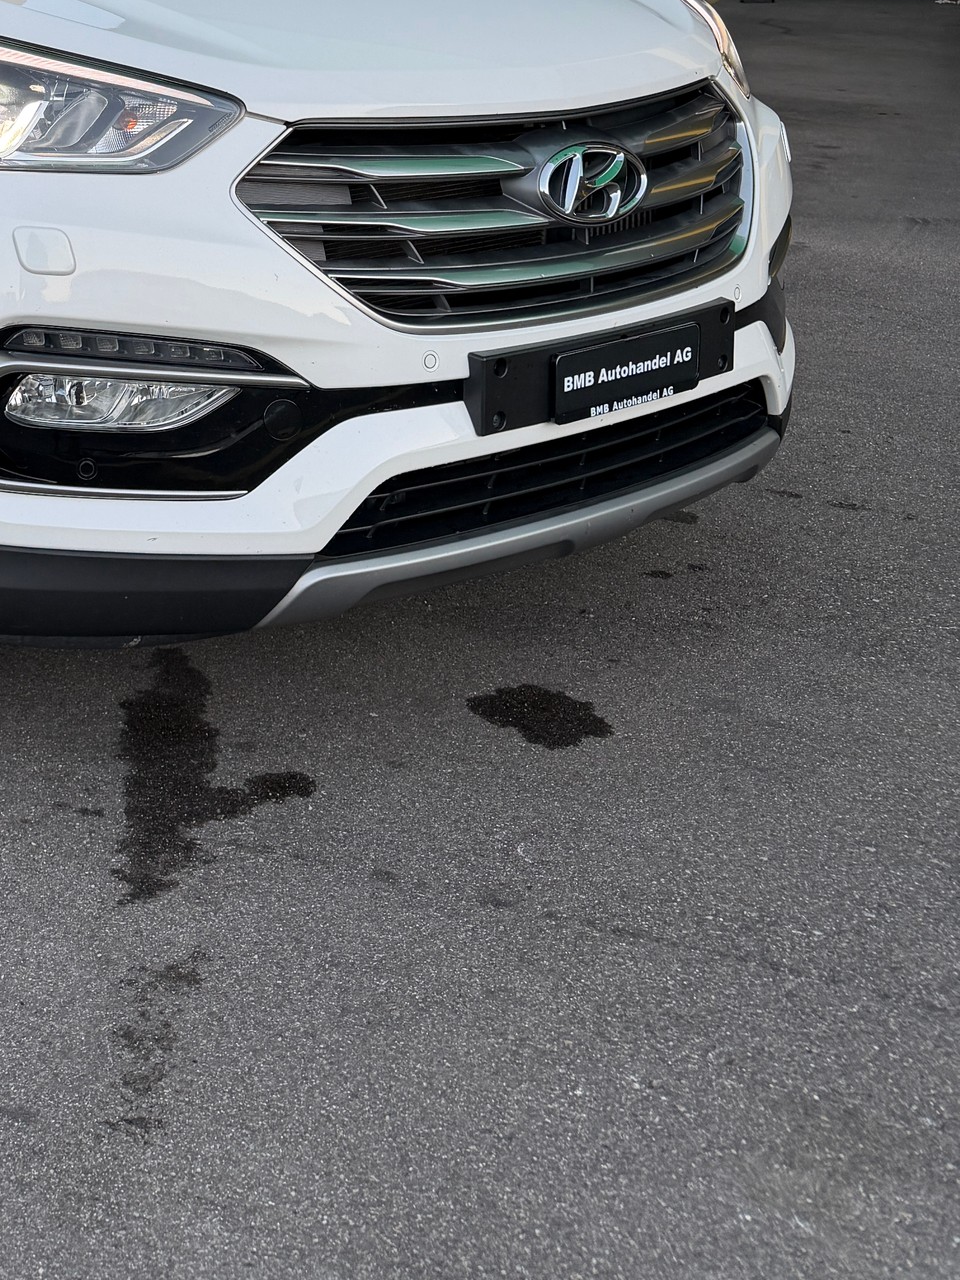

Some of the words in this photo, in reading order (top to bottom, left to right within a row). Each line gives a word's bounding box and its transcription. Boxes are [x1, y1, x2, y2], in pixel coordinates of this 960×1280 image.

[564, 371, 594, 392] BMB
[598, 352, 671, 384] Autohandel
[673, 347, 692, 365] AG
[590, 403, 609, 417] BMB
[612, 389, 660, 411] Autohandel
[662, 386, 674, 398] AG
